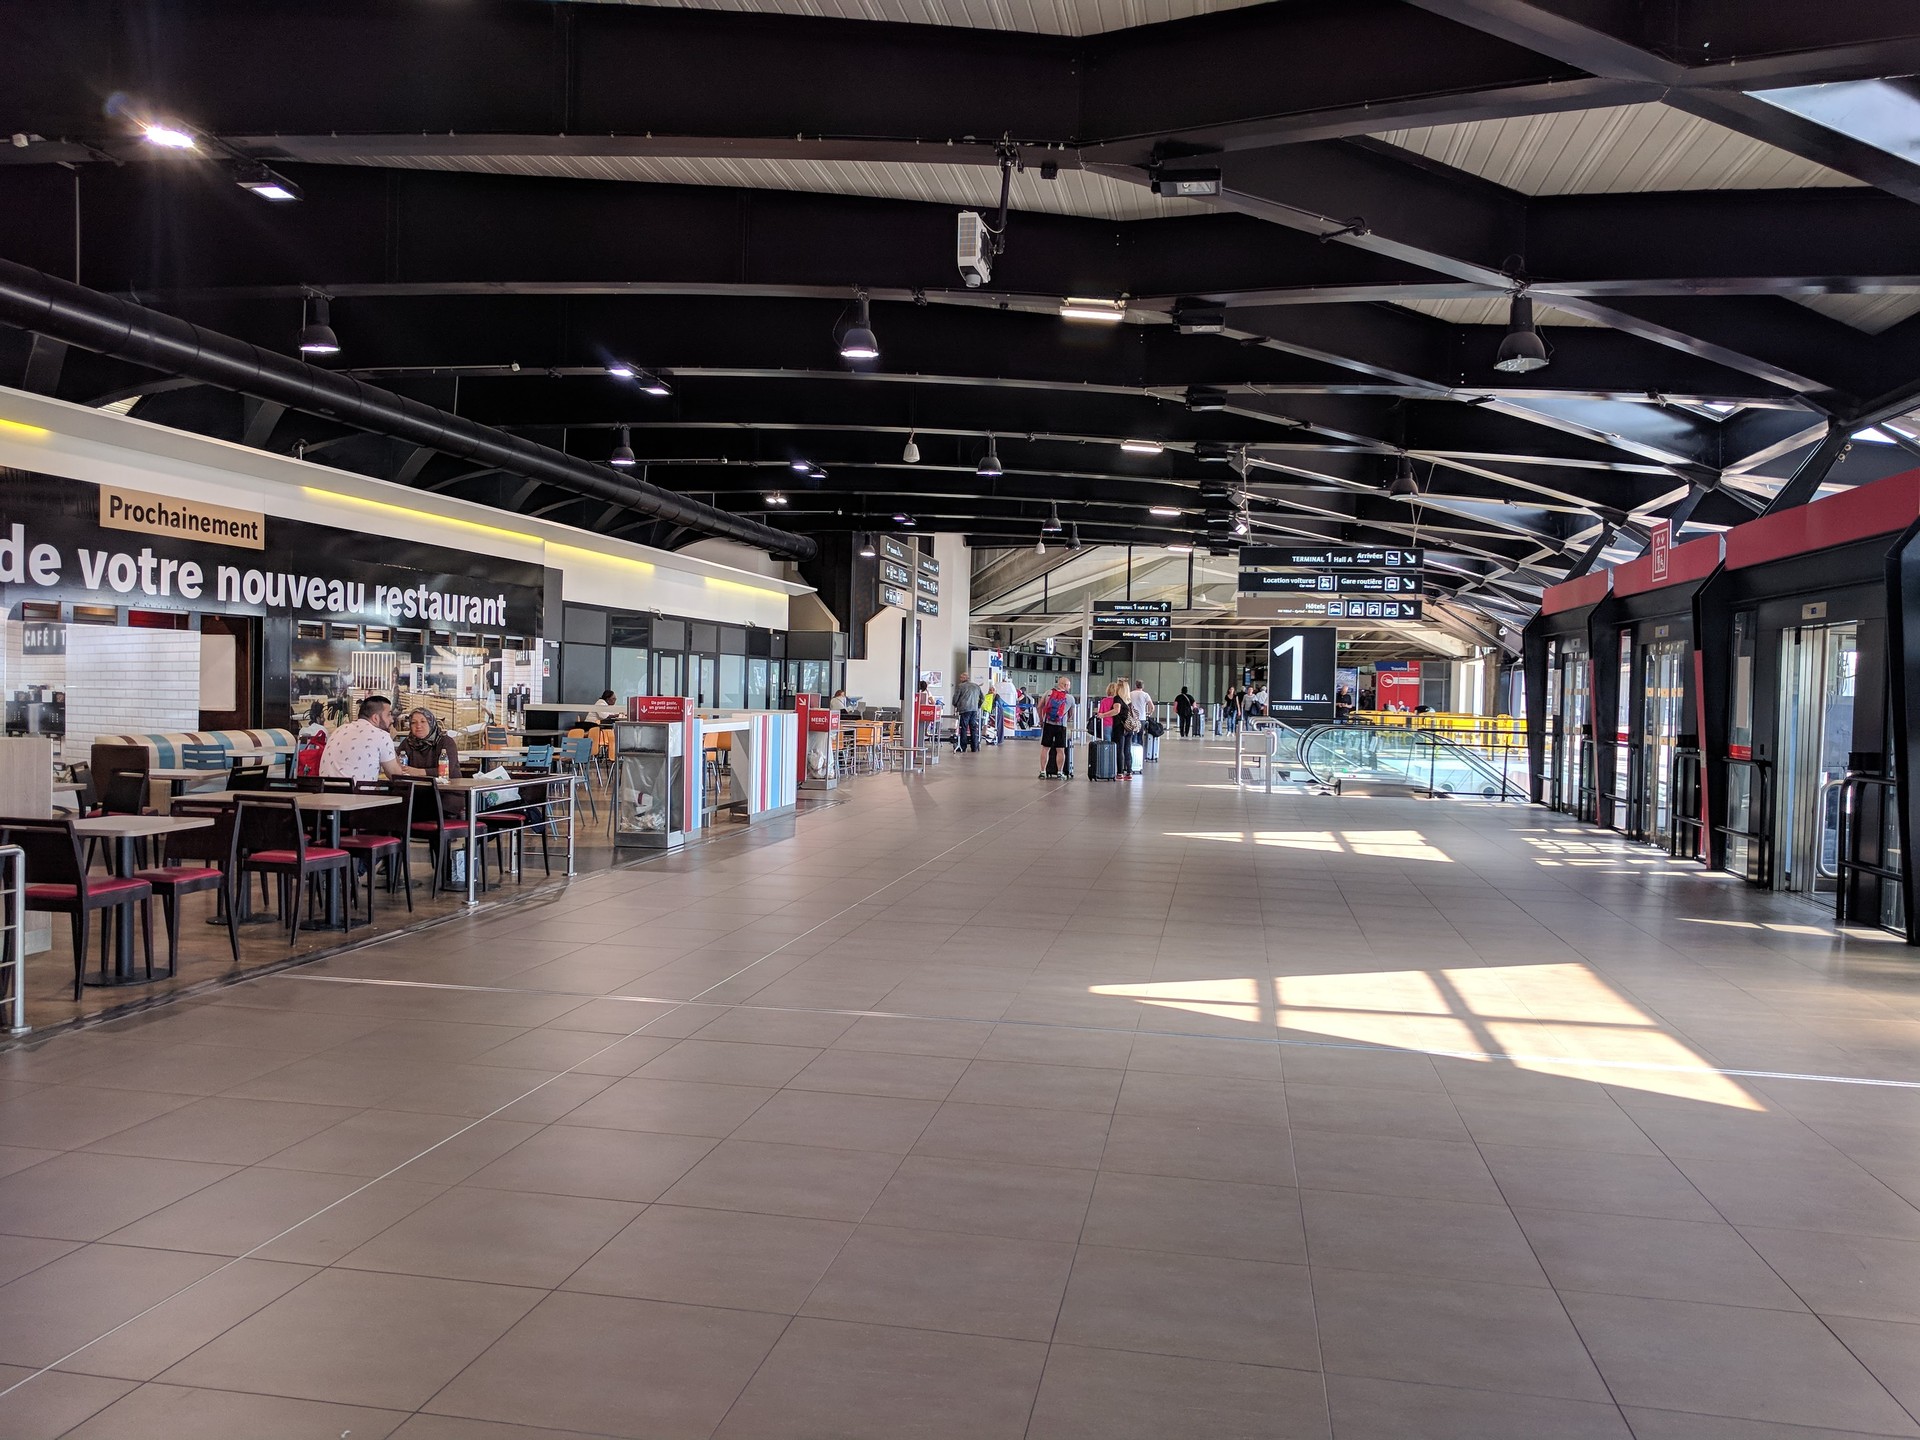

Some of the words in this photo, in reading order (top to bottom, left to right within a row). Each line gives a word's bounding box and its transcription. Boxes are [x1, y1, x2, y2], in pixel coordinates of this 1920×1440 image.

[108, 494, 259, 541] Prochainement
[1326, 552, 1332, 563] 1
[1357, 552, 1383, 560] Arrivées
[0, 523, 62, 586] de
[77, 547, 204, 599] votre
[217, 564, 365, 614] nouveau
[374, 583, 507, 627] restaurant
[1263, 577, 1289, 585] Location
[1290, 577, 1315, 585] voitures
[1341, 578, 1356, 586] Gare
[1356, 578, 1383, 586] routière
[1305, 602, 1326, 610] Hôtels
[1127, 617, 1135, 625] 16
[1140, 617, 1149, 625] 19
[24, 626, 49, 647] CAFÉ
[1046, 638, 1054, 655] 19
[1272, 635, 1304, 701] 1
[1304, 693, 1320, 701] Hall
[1321, 693, 1328, 701] A
